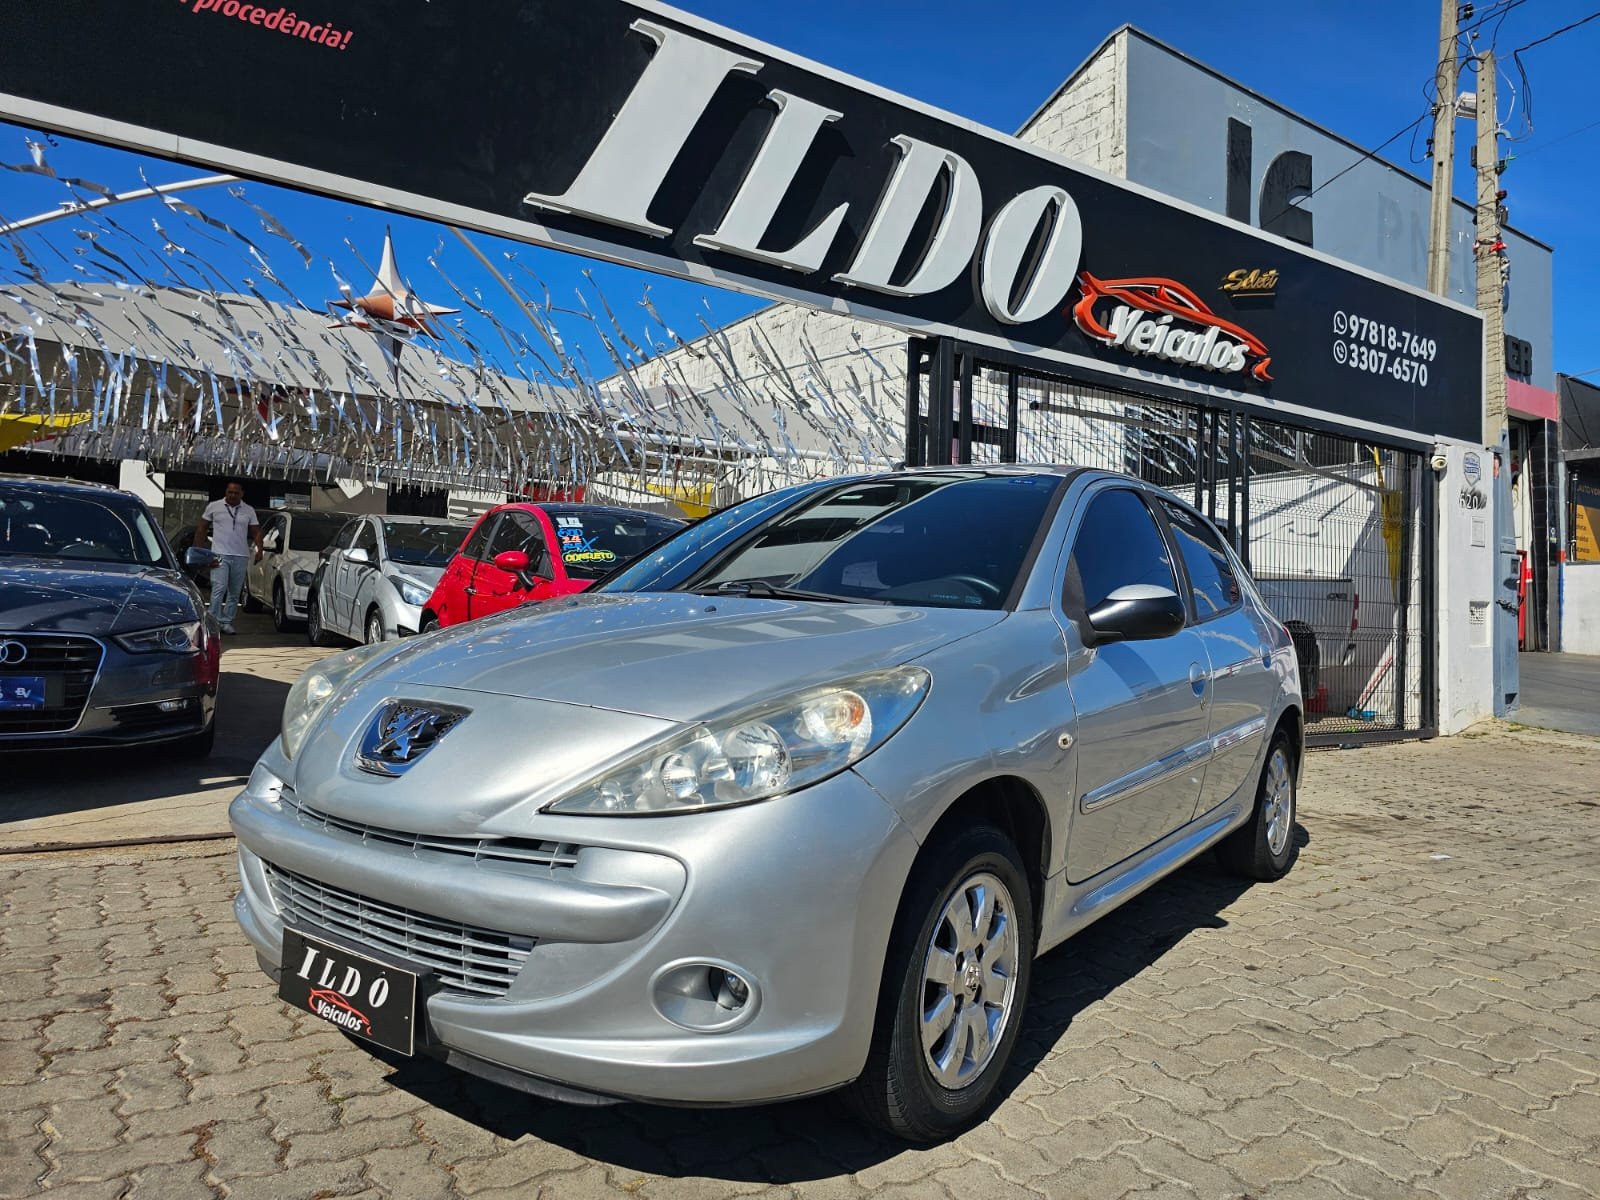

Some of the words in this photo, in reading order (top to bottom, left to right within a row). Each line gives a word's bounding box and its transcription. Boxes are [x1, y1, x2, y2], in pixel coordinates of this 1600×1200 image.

[523, 18, 1083, 325] ILDO
[1108, 304, 1250, 372] Veículos
[1349, 314, 1437, 362] 97818-7649
[1349, 344, 1429, 387] 3307-6570
[297, 946, 389, 1008] ILDO
